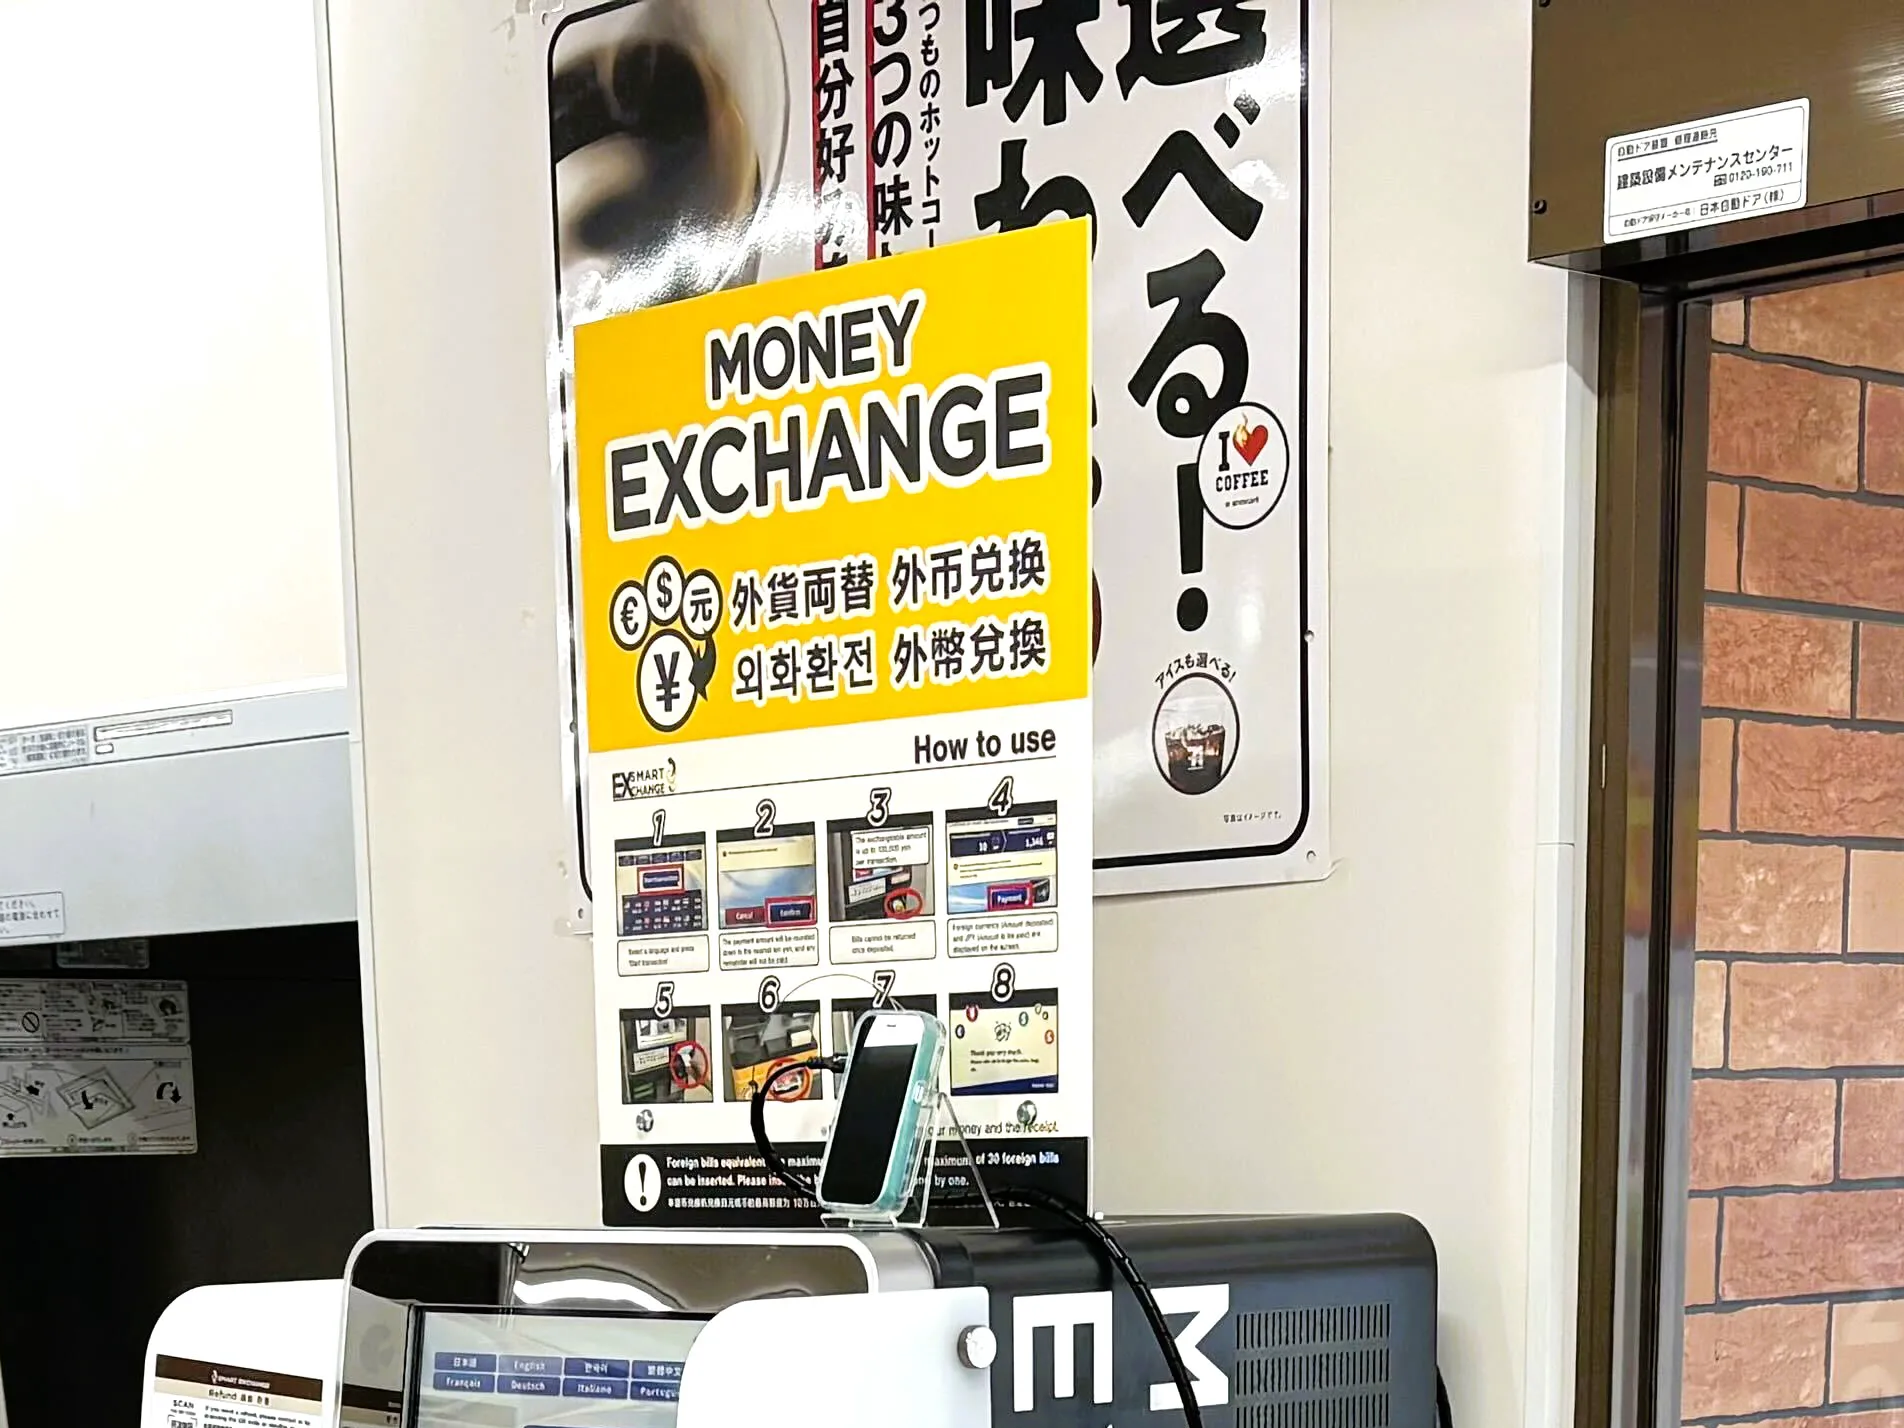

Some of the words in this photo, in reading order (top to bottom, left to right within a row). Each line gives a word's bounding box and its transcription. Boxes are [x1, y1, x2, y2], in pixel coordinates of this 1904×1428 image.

[1617, 144, 1793, 190] 建築設備メンテナンスセンター
[710, 300, 920, 401] MONEY
[611, 376, 1045, 531] EXCHANGE
[1215, 469, 1269, 492] COFFEE
[893, 540, 1046, 610] 外币兑换
[733, 566, 874, 629] 外貨両替
[737, 636, 874, 703] 외화환전
[895, 620, 1046, 684] 外幣兌換
[914, 731, 969, 767] How
[977, 733, 1002, 759] to
[1012, 729, 1056, 755] use
[867, 788, 891, 826] 3
[988, 777, 1013, 816] 4
[652, 810, 666, 847] 1
[754, 799, 775, 837] 2
[655, 982, 674, 1017] 5
[759, 976, 780, 1012] 6
[873, 971, 895, 1006] 7
[992, 965, 1015, 1002] 8
[446, 1376, 481, 1390] Français
[514, 1360, 545, 1373] English
[173, 1400, 194, 1409] SCAN
[209, 1389, 237, 1400] Refund
[511, 1380, 545, 1392] Deutsch
[577, 1383, 612, 1395] Italiano
